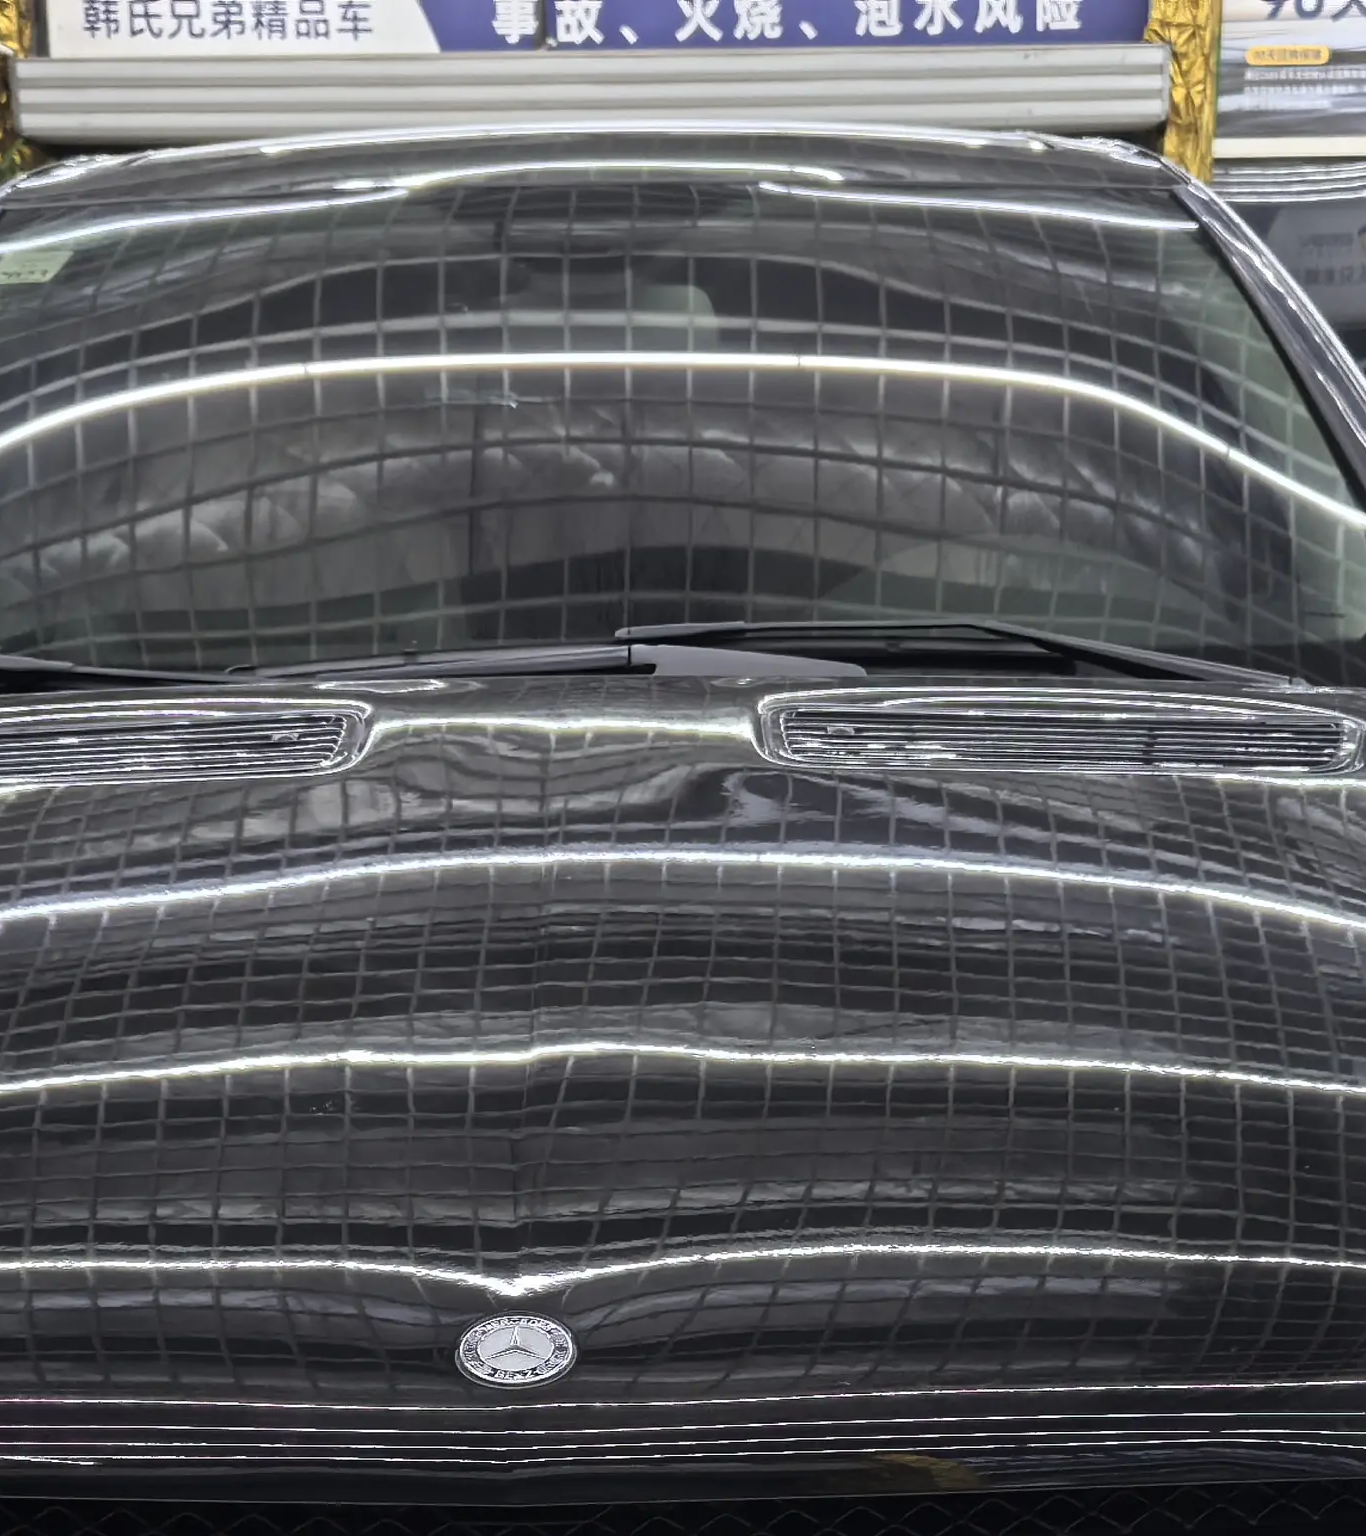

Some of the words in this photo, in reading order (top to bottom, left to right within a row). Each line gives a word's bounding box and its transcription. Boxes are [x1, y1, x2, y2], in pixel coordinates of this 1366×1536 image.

[83, 0, 374, 41] 韩氏兄弟精品车
